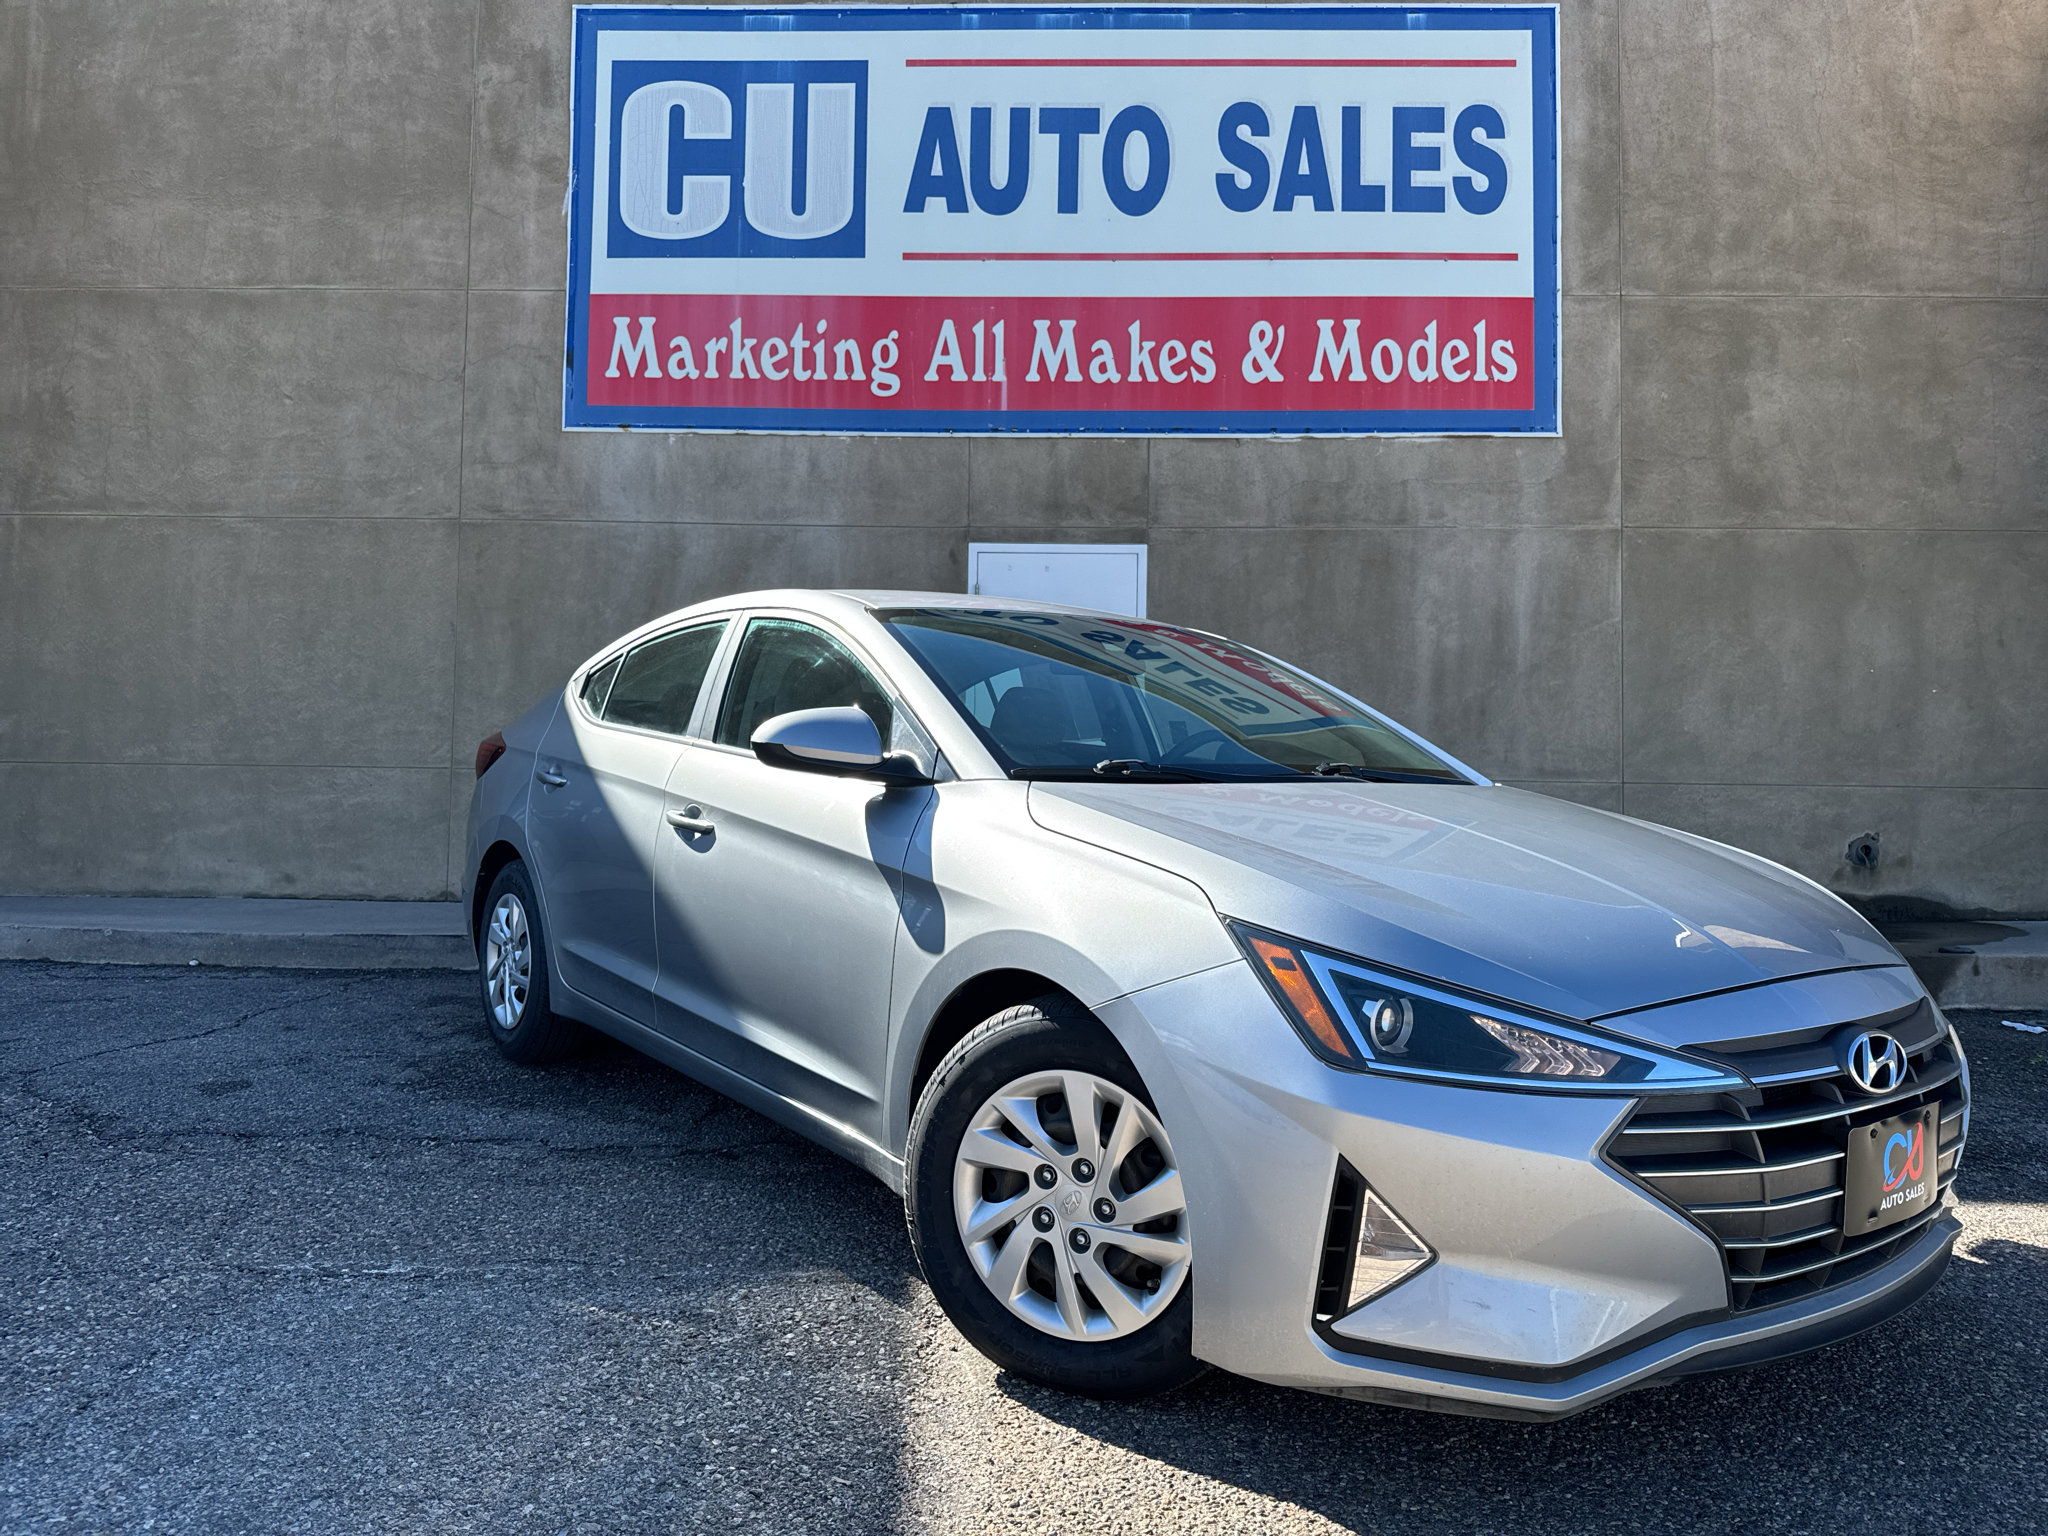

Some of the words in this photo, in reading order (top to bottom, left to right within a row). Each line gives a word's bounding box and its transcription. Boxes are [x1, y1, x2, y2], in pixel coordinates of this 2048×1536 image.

[620, 80, 857, 240] CU
[903, 104, 1171, 217] AUTO
[1215, 101, 1508, 215] SALES
[605, 316, 901, 397] Marketing
[924, 318, 1006, 383] All
[1025, 319, 1217, 384] Makes
[1241, 320, 1285, 384] &
[1308, 319, 1518, 384] Models
[1880, 1191, 1904, 1211] AUTO
[1905, 1181, 1925, 1202] SALES
